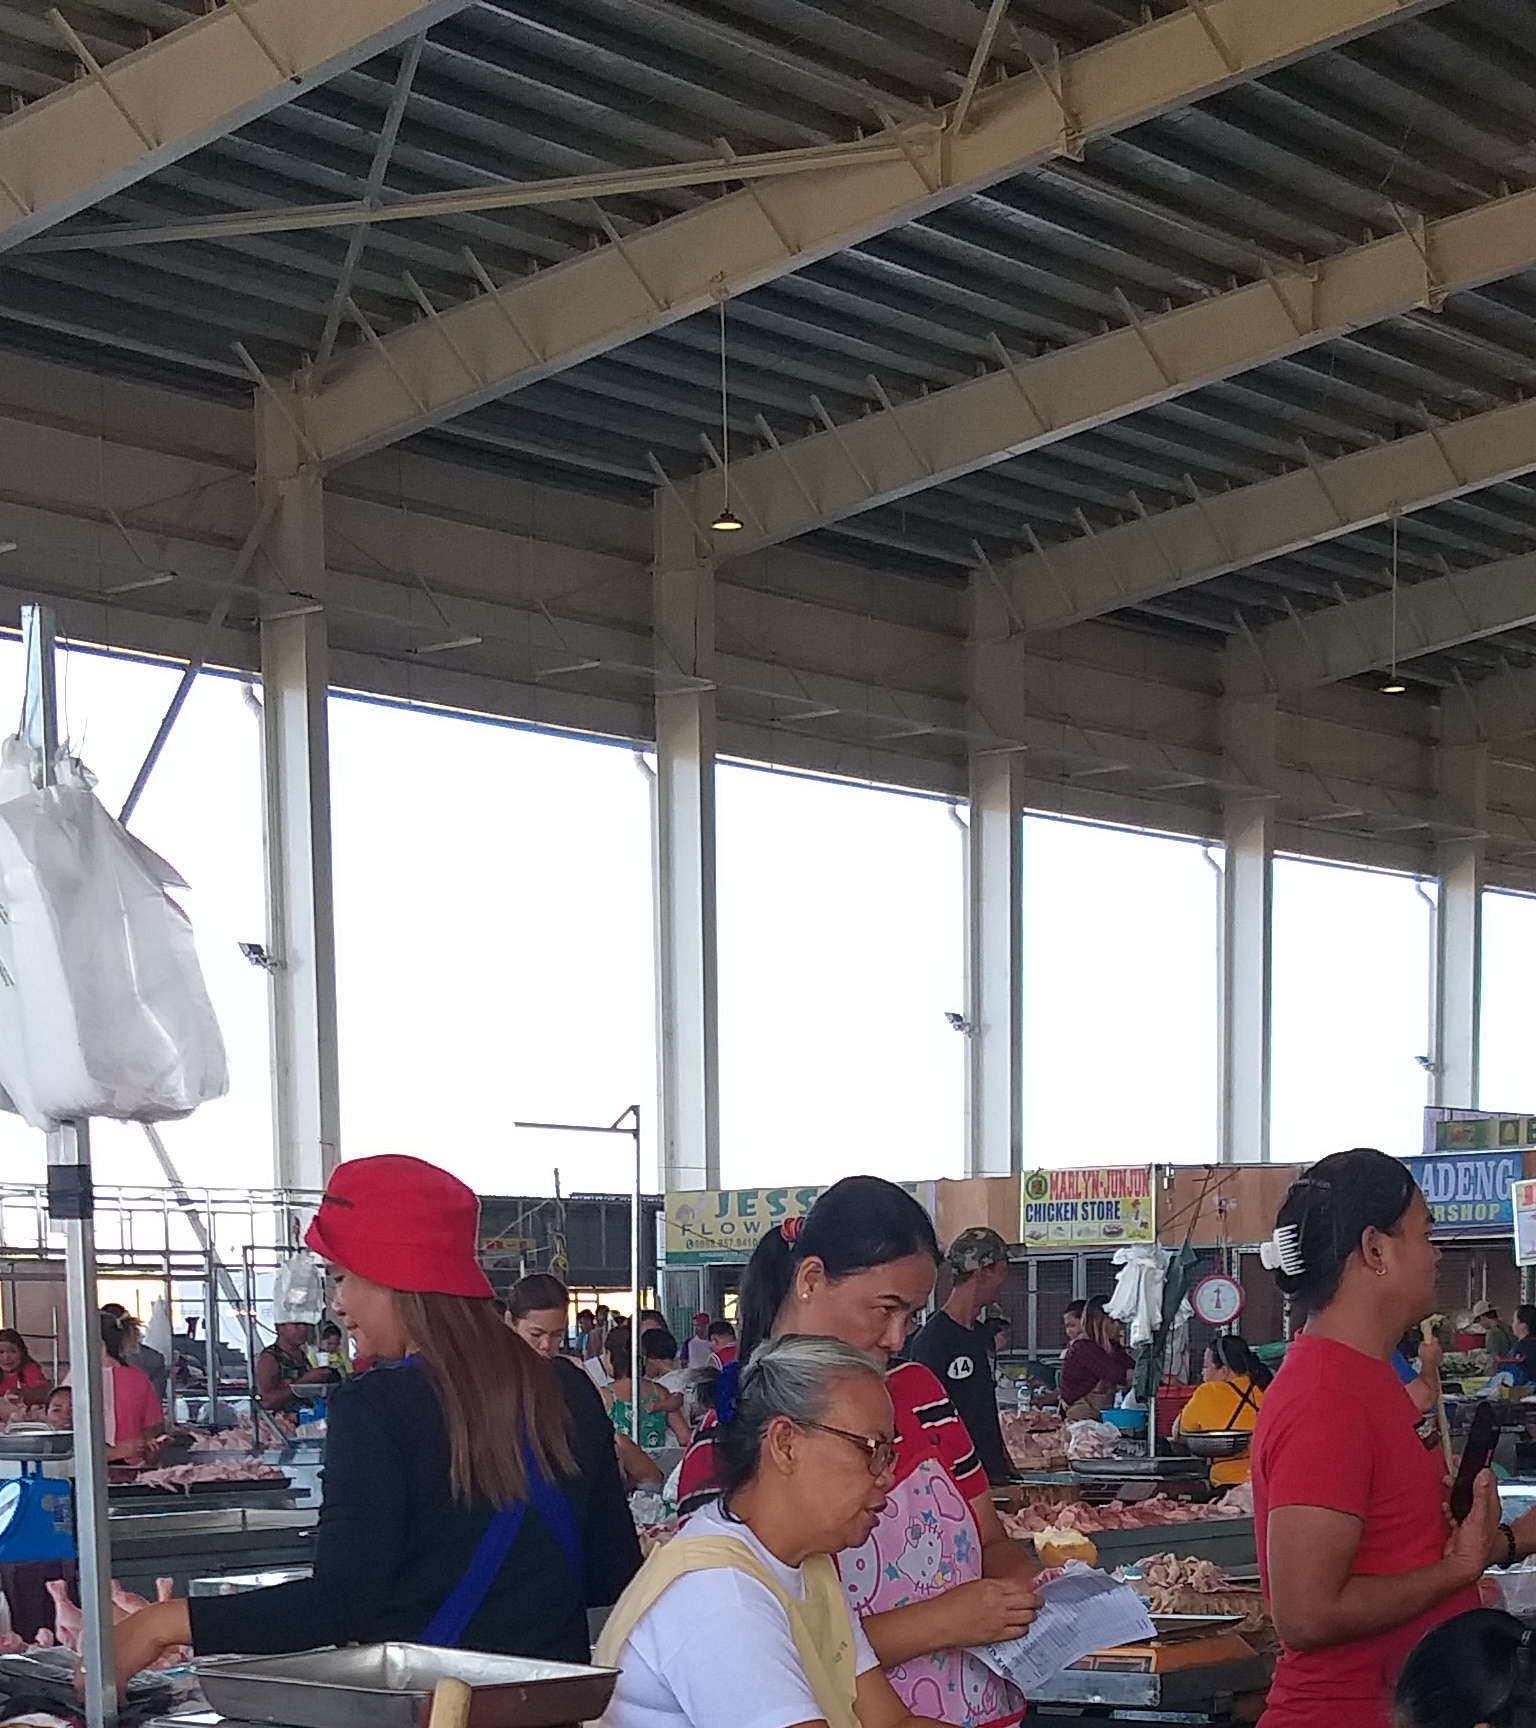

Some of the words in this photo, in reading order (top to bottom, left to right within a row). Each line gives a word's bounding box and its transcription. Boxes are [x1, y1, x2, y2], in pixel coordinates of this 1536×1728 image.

[1049, 1168, 1151, 1201] MARLYN-JUNJUN
[1025, 1201, 1078, 1223] CHICKEN
[1081, 1200, 1121, 1221] STORE
[953, 1359, 971, 1376] 14
